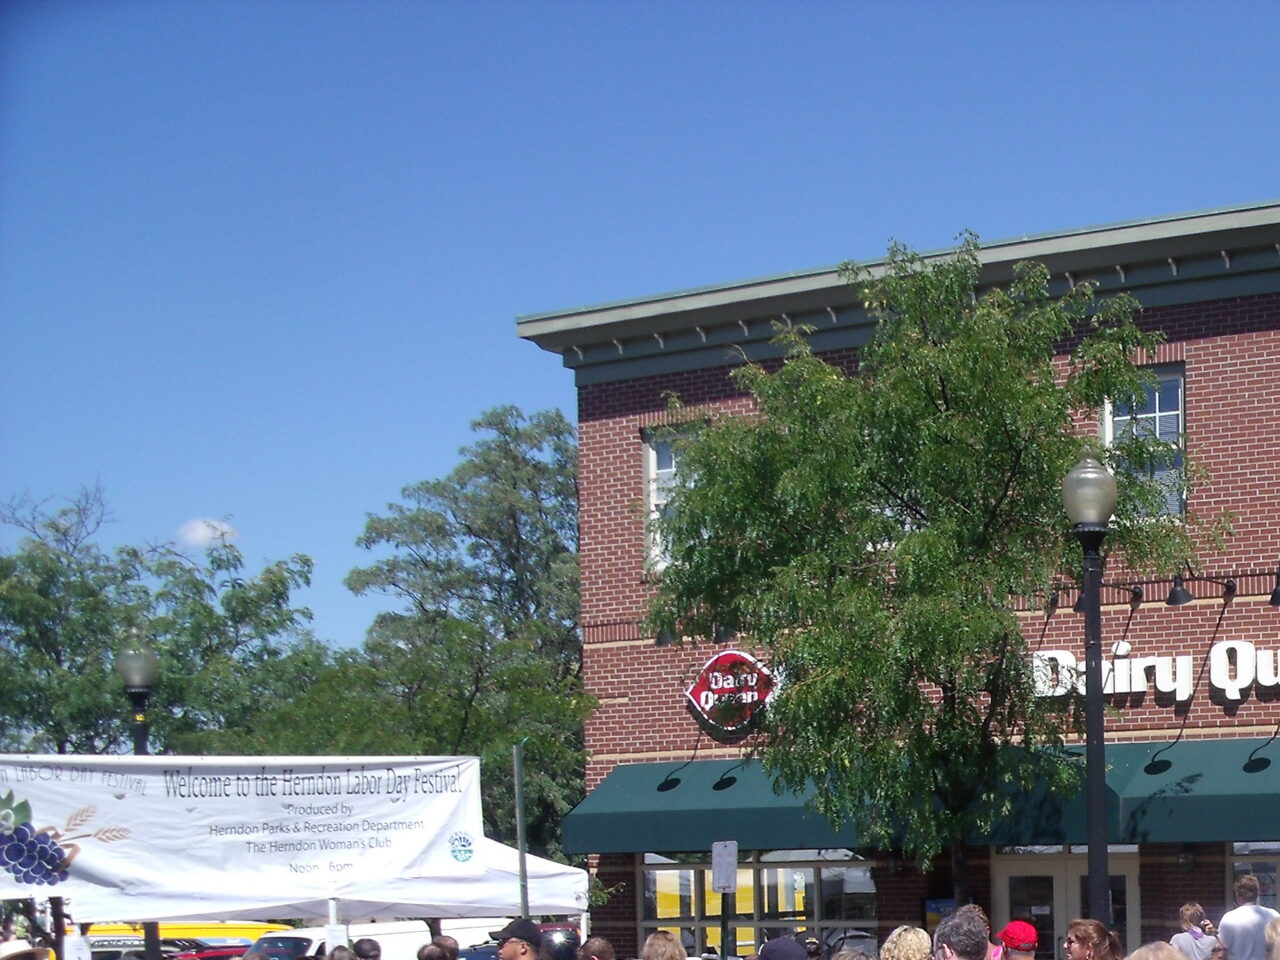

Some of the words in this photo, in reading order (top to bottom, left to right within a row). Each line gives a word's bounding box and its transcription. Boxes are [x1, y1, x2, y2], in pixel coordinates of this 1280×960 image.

[16, 765, 63, 783] LABOR
[70, 766, 96, 783] DAY
[101, 770, 147, 796] FESTIVAL
[163, 766, 231, 798] Welcome
[236, 772, 250, 797] to
[255, 766, 278, 797] the
[282, 766, 342, 796] Herndon
[346, 765, 382, 795] Labor
[386, 767, 410, 802] Day
[414, 764, 463, 794] Festival
[288, 803, 338, 816] Produced
[341, 802, 353, 817] by
[209, 823, 259, 836] Herndon
[262, 822, 290, 834] Parks
[293, 822, 301, 833] &
[304, 821, 360, 833] Recreation
[362, 819, 424, 834] Department
[246, 841, 266, 853] The
[269, 840, 317, 852] Herndon
[319, 838, 367, 850] Woman's
[368, 836, 392, 849] Club
[288, 863, 320, 874] Noon
